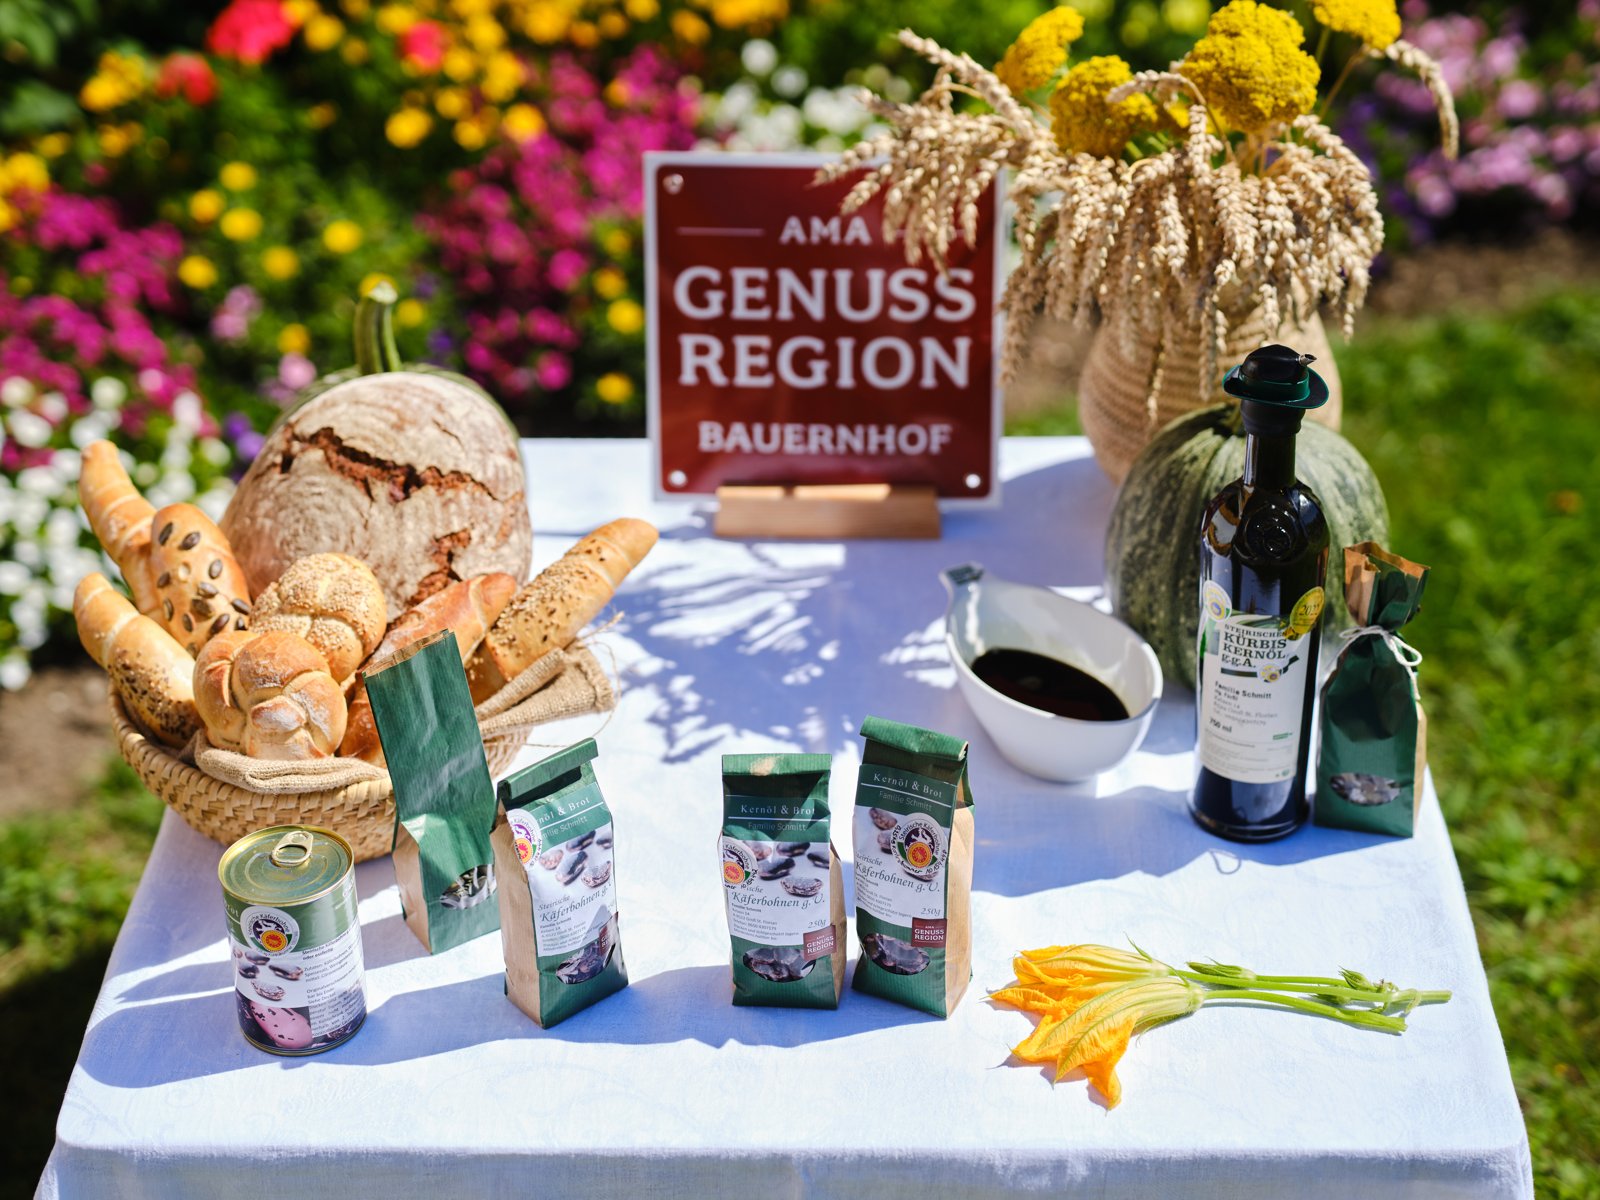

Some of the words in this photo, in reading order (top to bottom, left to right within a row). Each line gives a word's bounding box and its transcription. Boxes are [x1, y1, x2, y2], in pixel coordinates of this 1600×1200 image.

[779, 216, 872, 245] AMA
[674, 266, 977, 321] GENUSS
[678, 334, 971, 389] REGION
[698, 421, 952, 454] BAUERNHOF
[1224, 631, 1287, 649] KÜRBIS
[1223, 642, 1286, 660] KERNÖL
[1215, 681, 1240, 695] Familie
[1242, 690, 1272, 699] Schmitt
[873, 773, 908, 788] Kernöl
[911, 781, 920, 791] &
[923, 785, 942, 798] Brot
[557, 806, 567, 816] &
[568, 796, 590, 811] Brot
[740, 804, 777, 814] Kernöl
[780, 805, 789, 815] &
[879, 791, 905, 803] Familie
[906, 797, 933, 812] Schmitt
[560, 816, 588, 831] Schmitt
[777, 823, 807, 832] Schmitt
[899, 821, 923, 840] Steirische
[923, 822, 940, 855] Käferbohne
[855, 861, 914, 889] Käferbohnen
[537, 895, 571, 911] Steirische
[540, 890, 600, 922] Käferbohnen
[731, 892, 799, 908] Käferbohnen
[226, 904, 239, 918] rot
[921, 907, 941, 917] 250g
[807, 919, 826, 929] 250g
[806, 936, 834, 948] GENUSS
[807, 941, 834, 954] REGION
